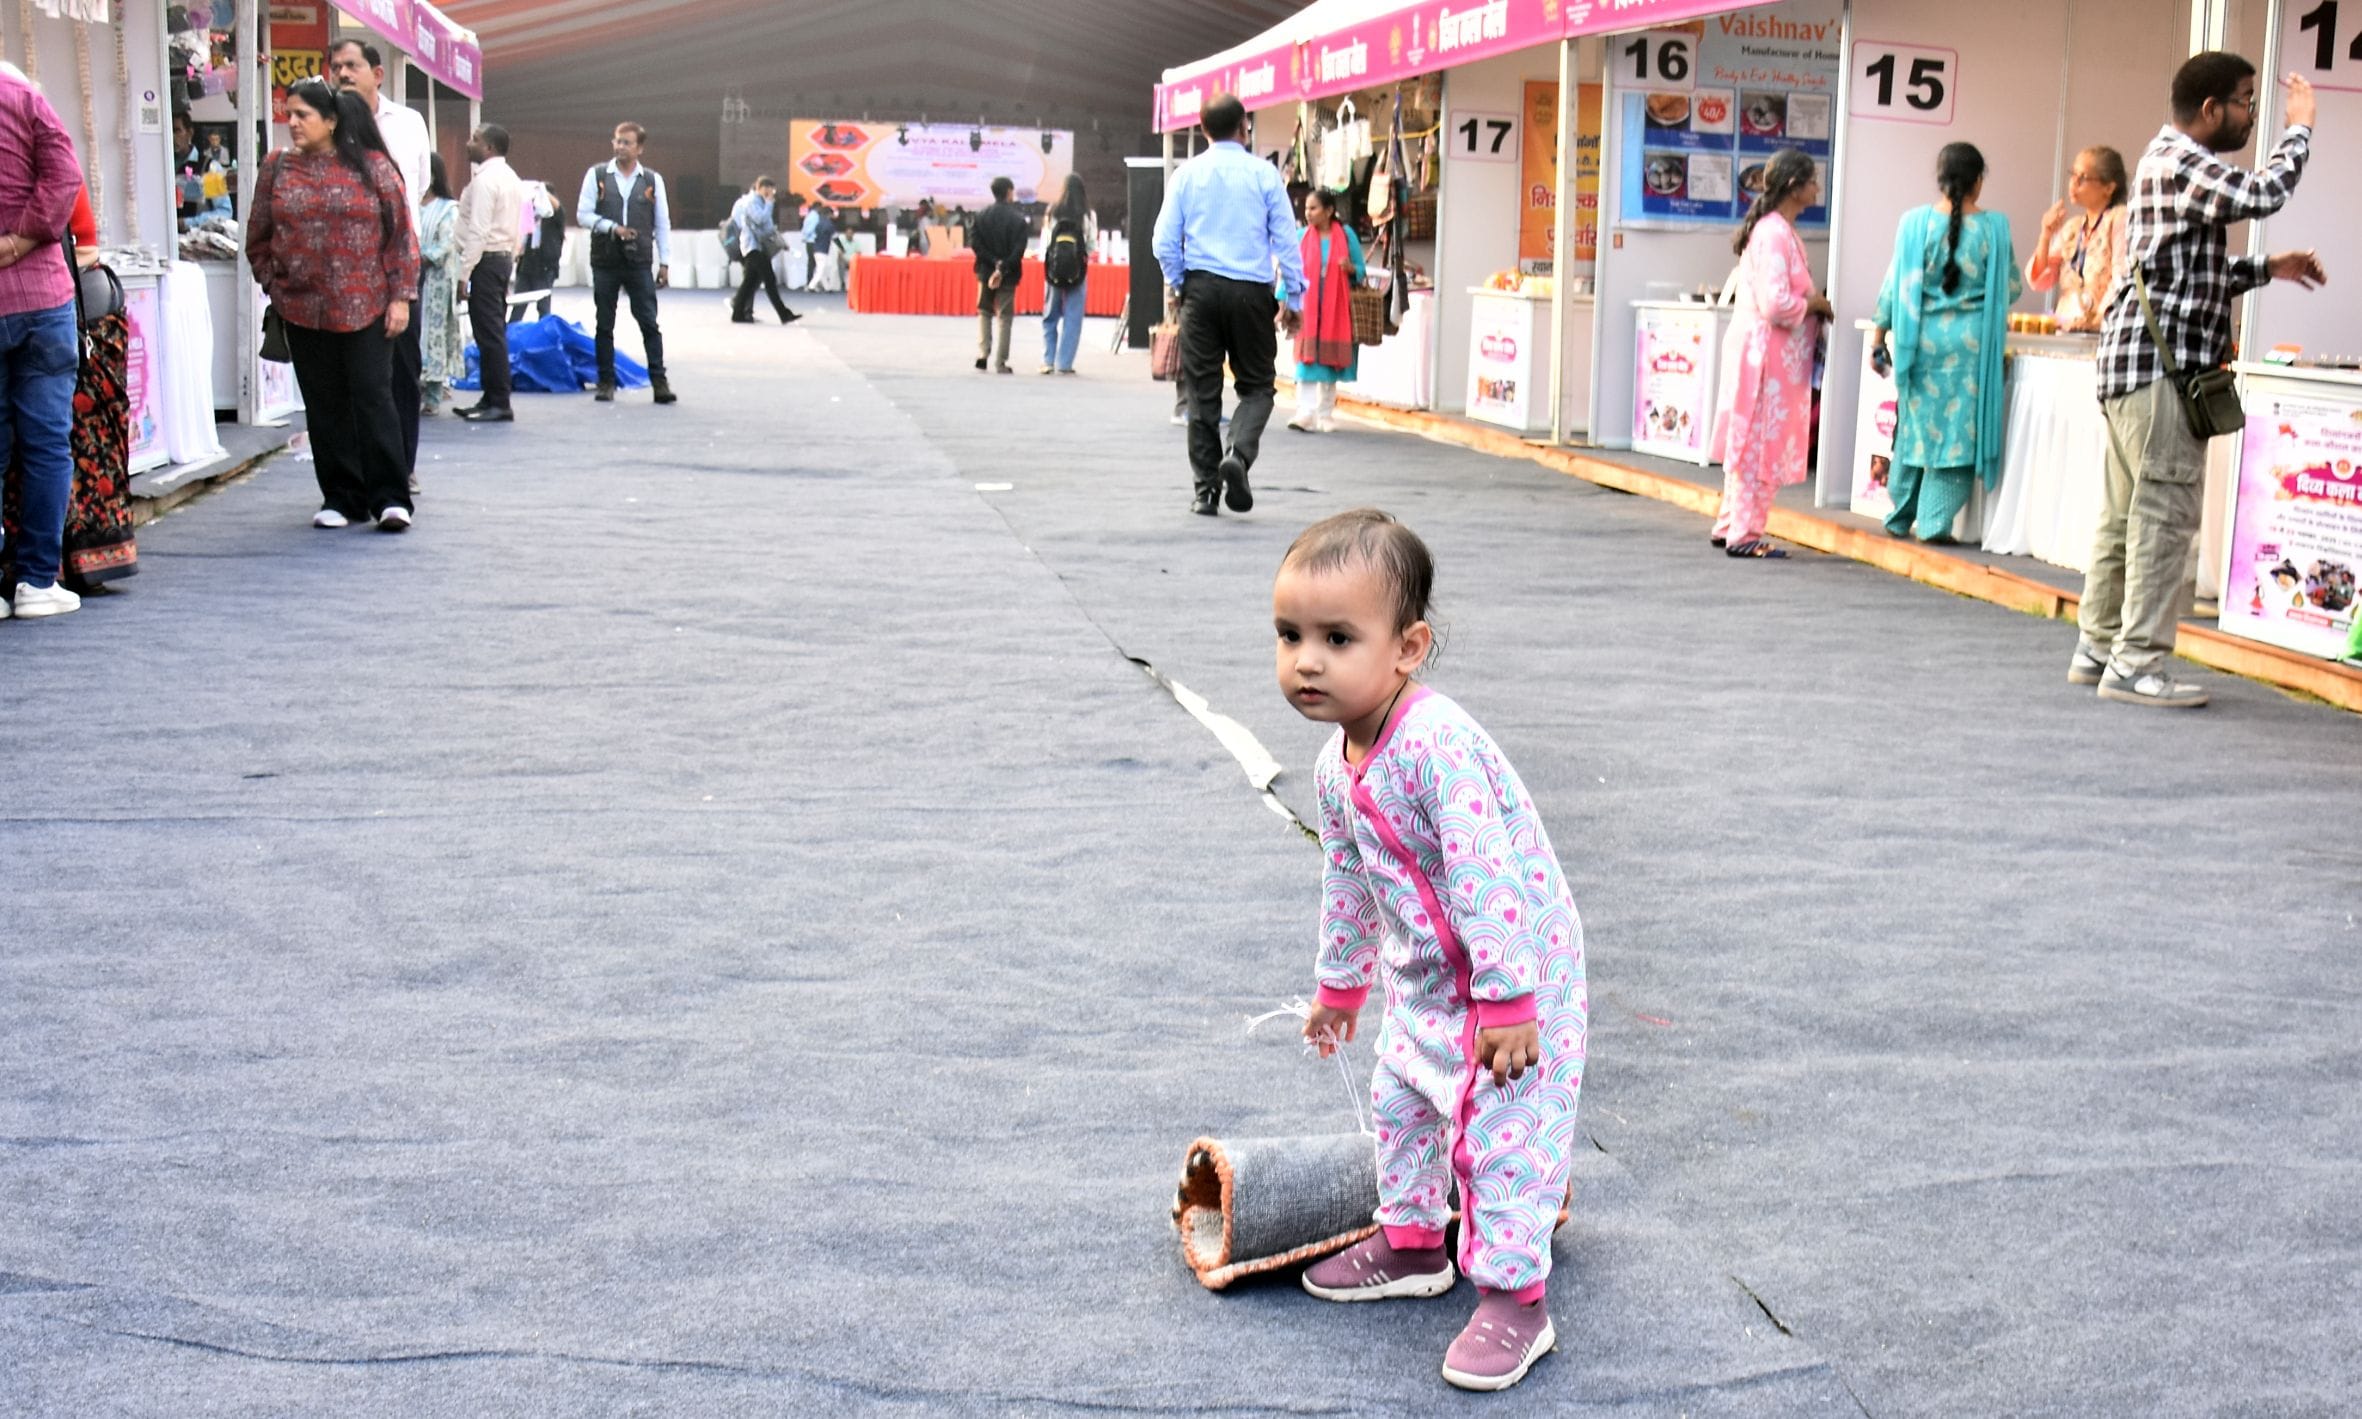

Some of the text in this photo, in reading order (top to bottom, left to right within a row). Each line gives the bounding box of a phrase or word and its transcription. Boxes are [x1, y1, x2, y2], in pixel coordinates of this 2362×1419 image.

[1625, 38, 1689, 81] 16
[1803, 49, 1812, 59] of
[1865, 54, 1945, 110] 15
[1459, 118, 1512, 154] 17
